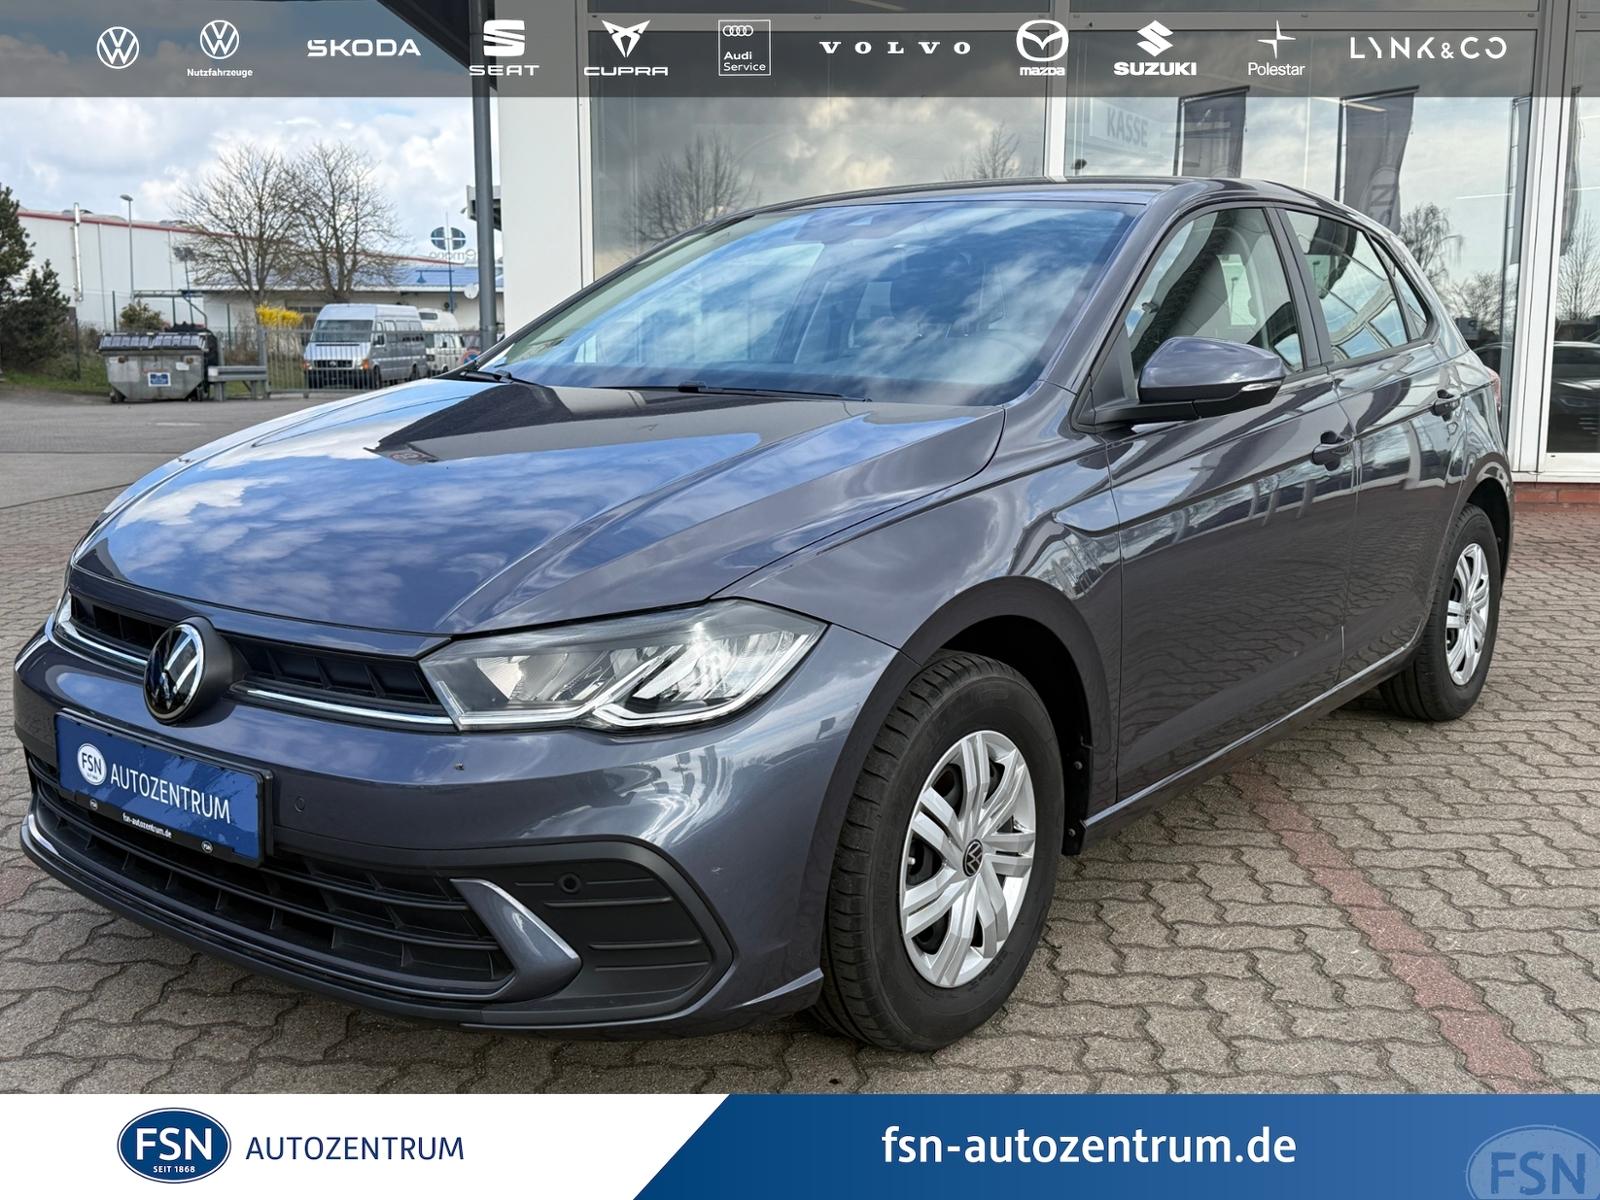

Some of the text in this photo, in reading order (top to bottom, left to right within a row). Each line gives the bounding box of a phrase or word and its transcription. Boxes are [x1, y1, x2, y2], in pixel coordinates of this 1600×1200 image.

[1107, 106, 1149, 148] KASSE
[82, 751, 231, 824] FSN AUTOZENTRUM
[122, 811, 172, 839] fsn-autozentrum.de
